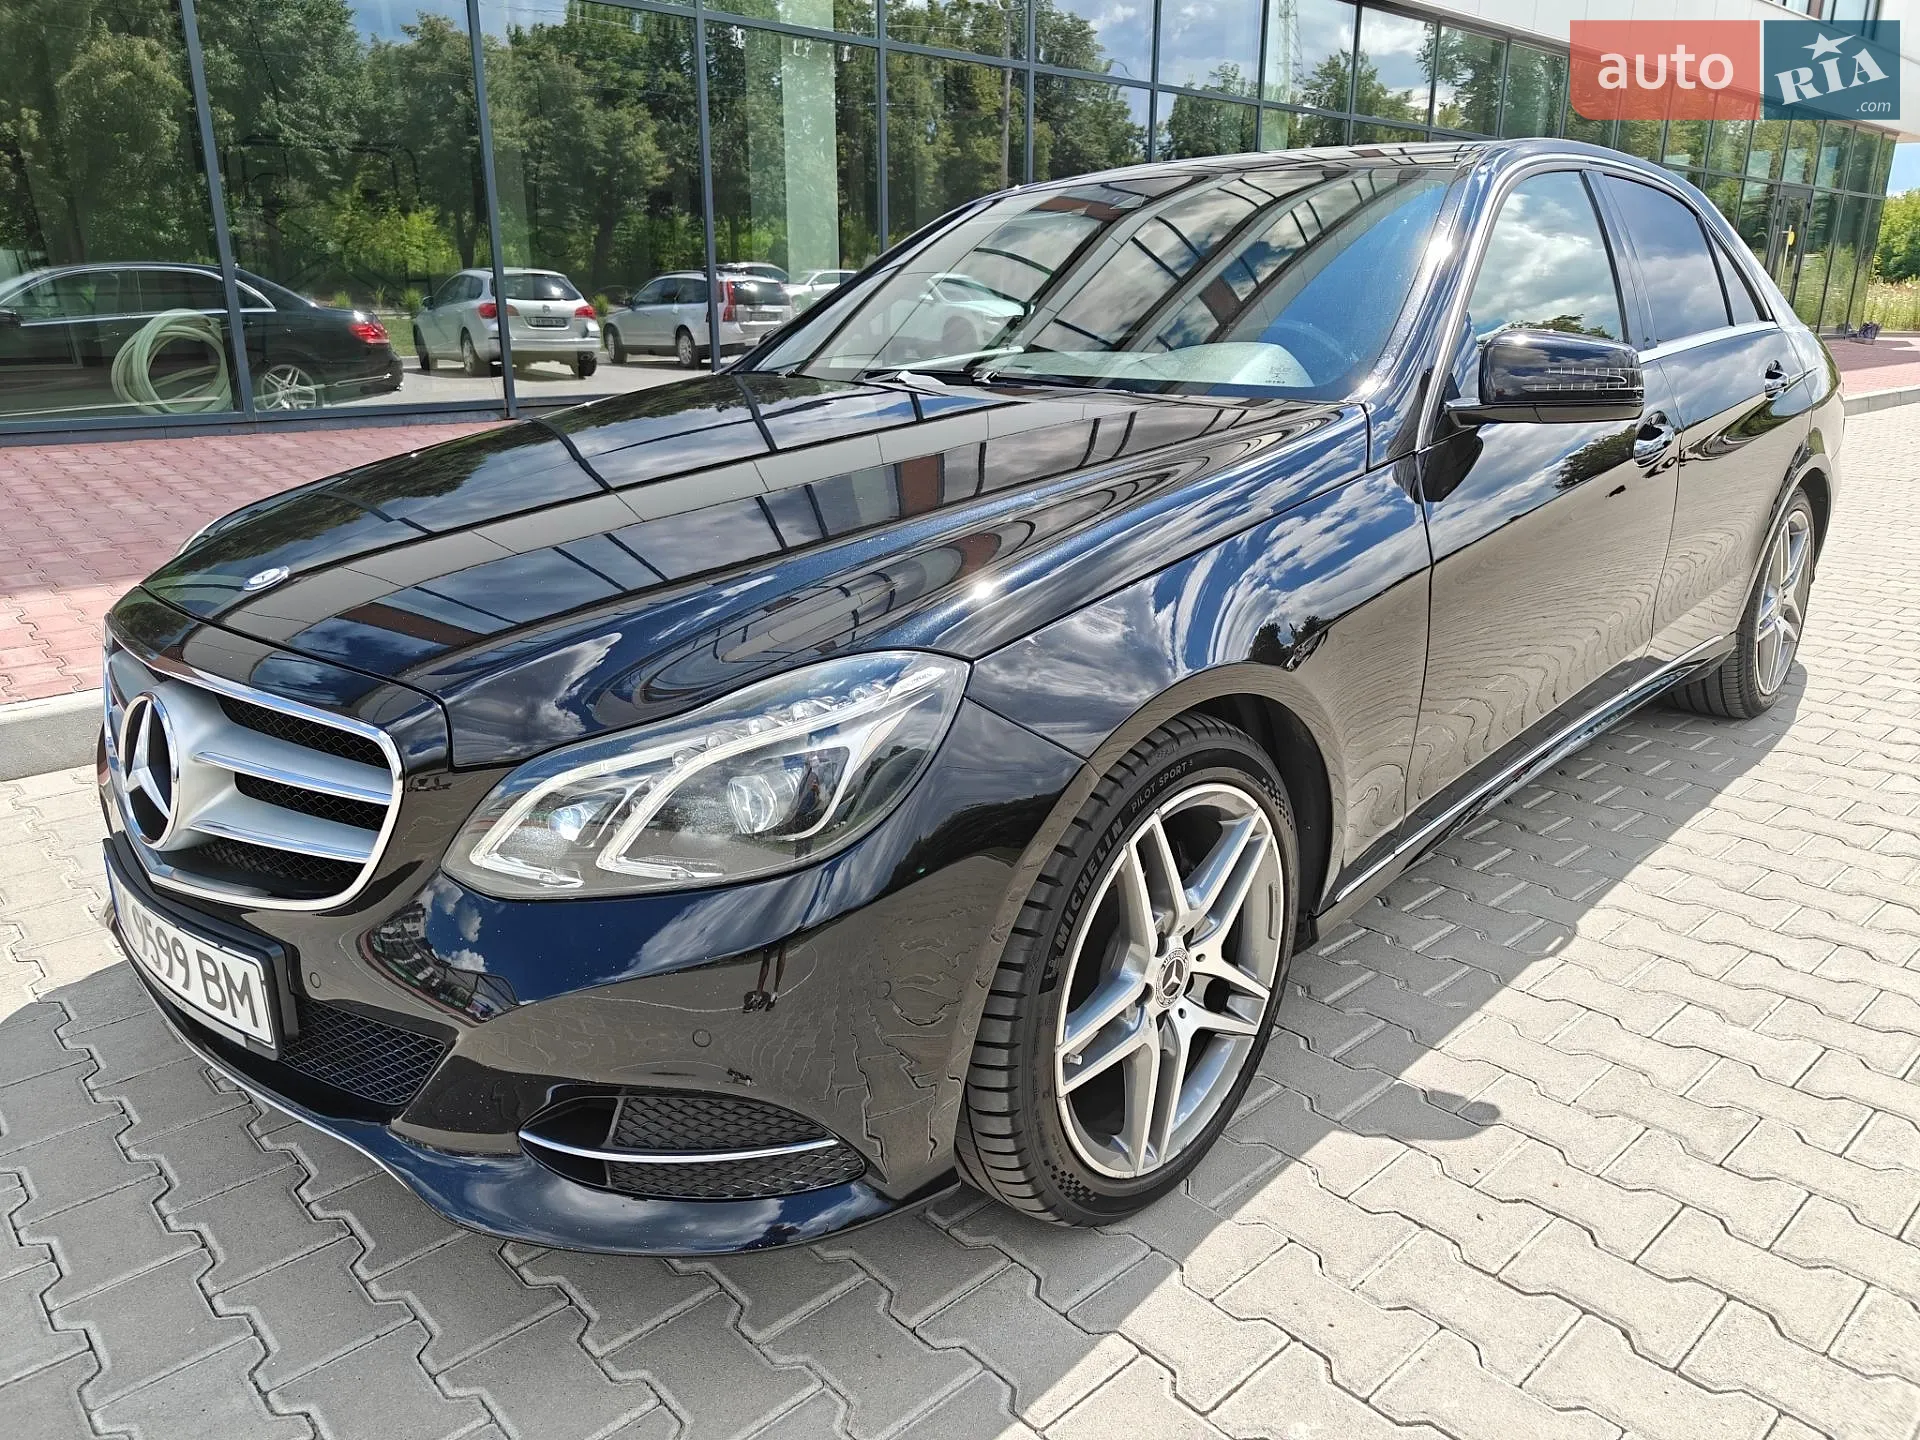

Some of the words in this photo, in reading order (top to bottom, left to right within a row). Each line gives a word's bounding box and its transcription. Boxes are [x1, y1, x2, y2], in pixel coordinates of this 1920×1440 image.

[1055, 817, 1124, 950] MICHELIN
[1131, 782, 1156, 812] PILOT
[1159, 761, 1187, 786] SPORT
[196, 949, 259, 1028] BM
